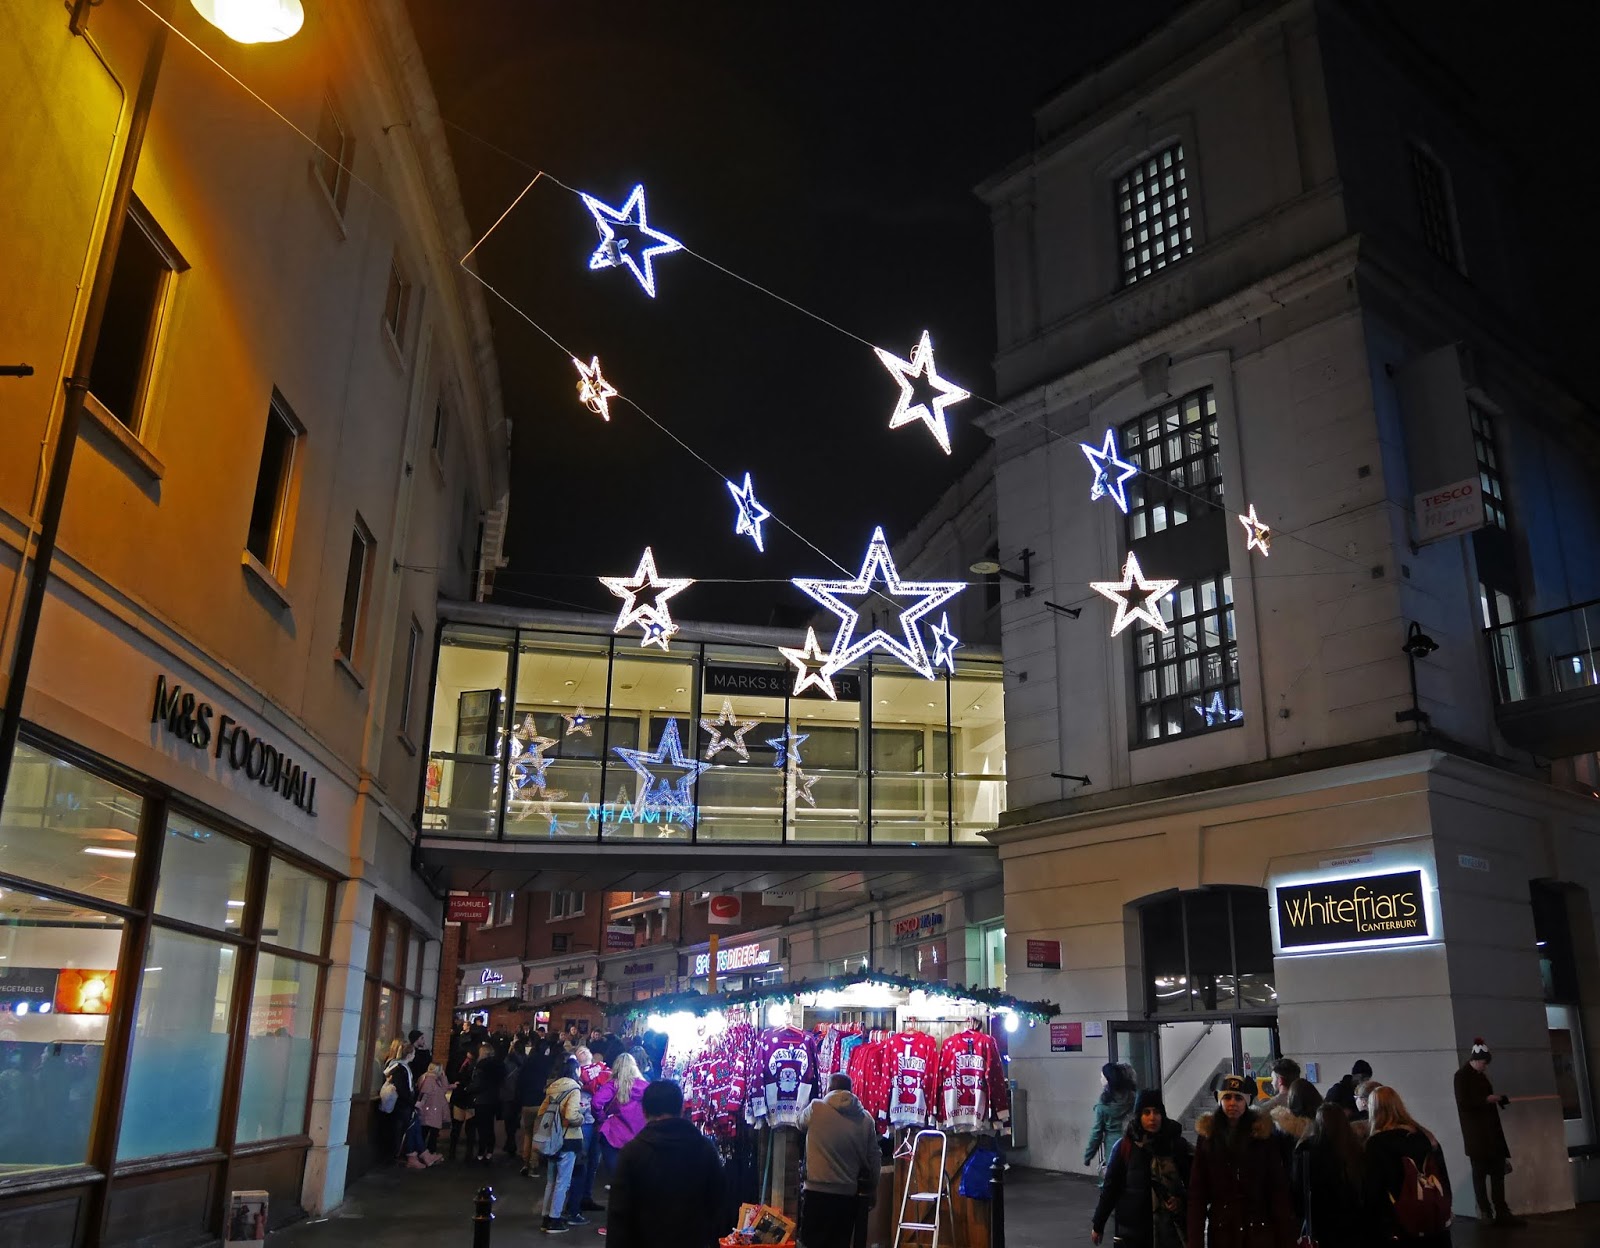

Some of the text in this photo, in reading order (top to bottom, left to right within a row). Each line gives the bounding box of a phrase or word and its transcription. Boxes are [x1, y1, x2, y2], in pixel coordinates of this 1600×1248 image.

[1422, 485, 1473, 507] TESCO
[714, 674, 767, 689] MARKS
[769, 678, 779, 690] &
[151, 674, 318, 817] M&S FOODHALL
[1284, 886, 1417, 932] Whitefriars
[894, 916, 920, 935] TESCO
[1361, 919, 1418, 932] CANTERBURY
[773, 1050, 791, 1060] WEST
